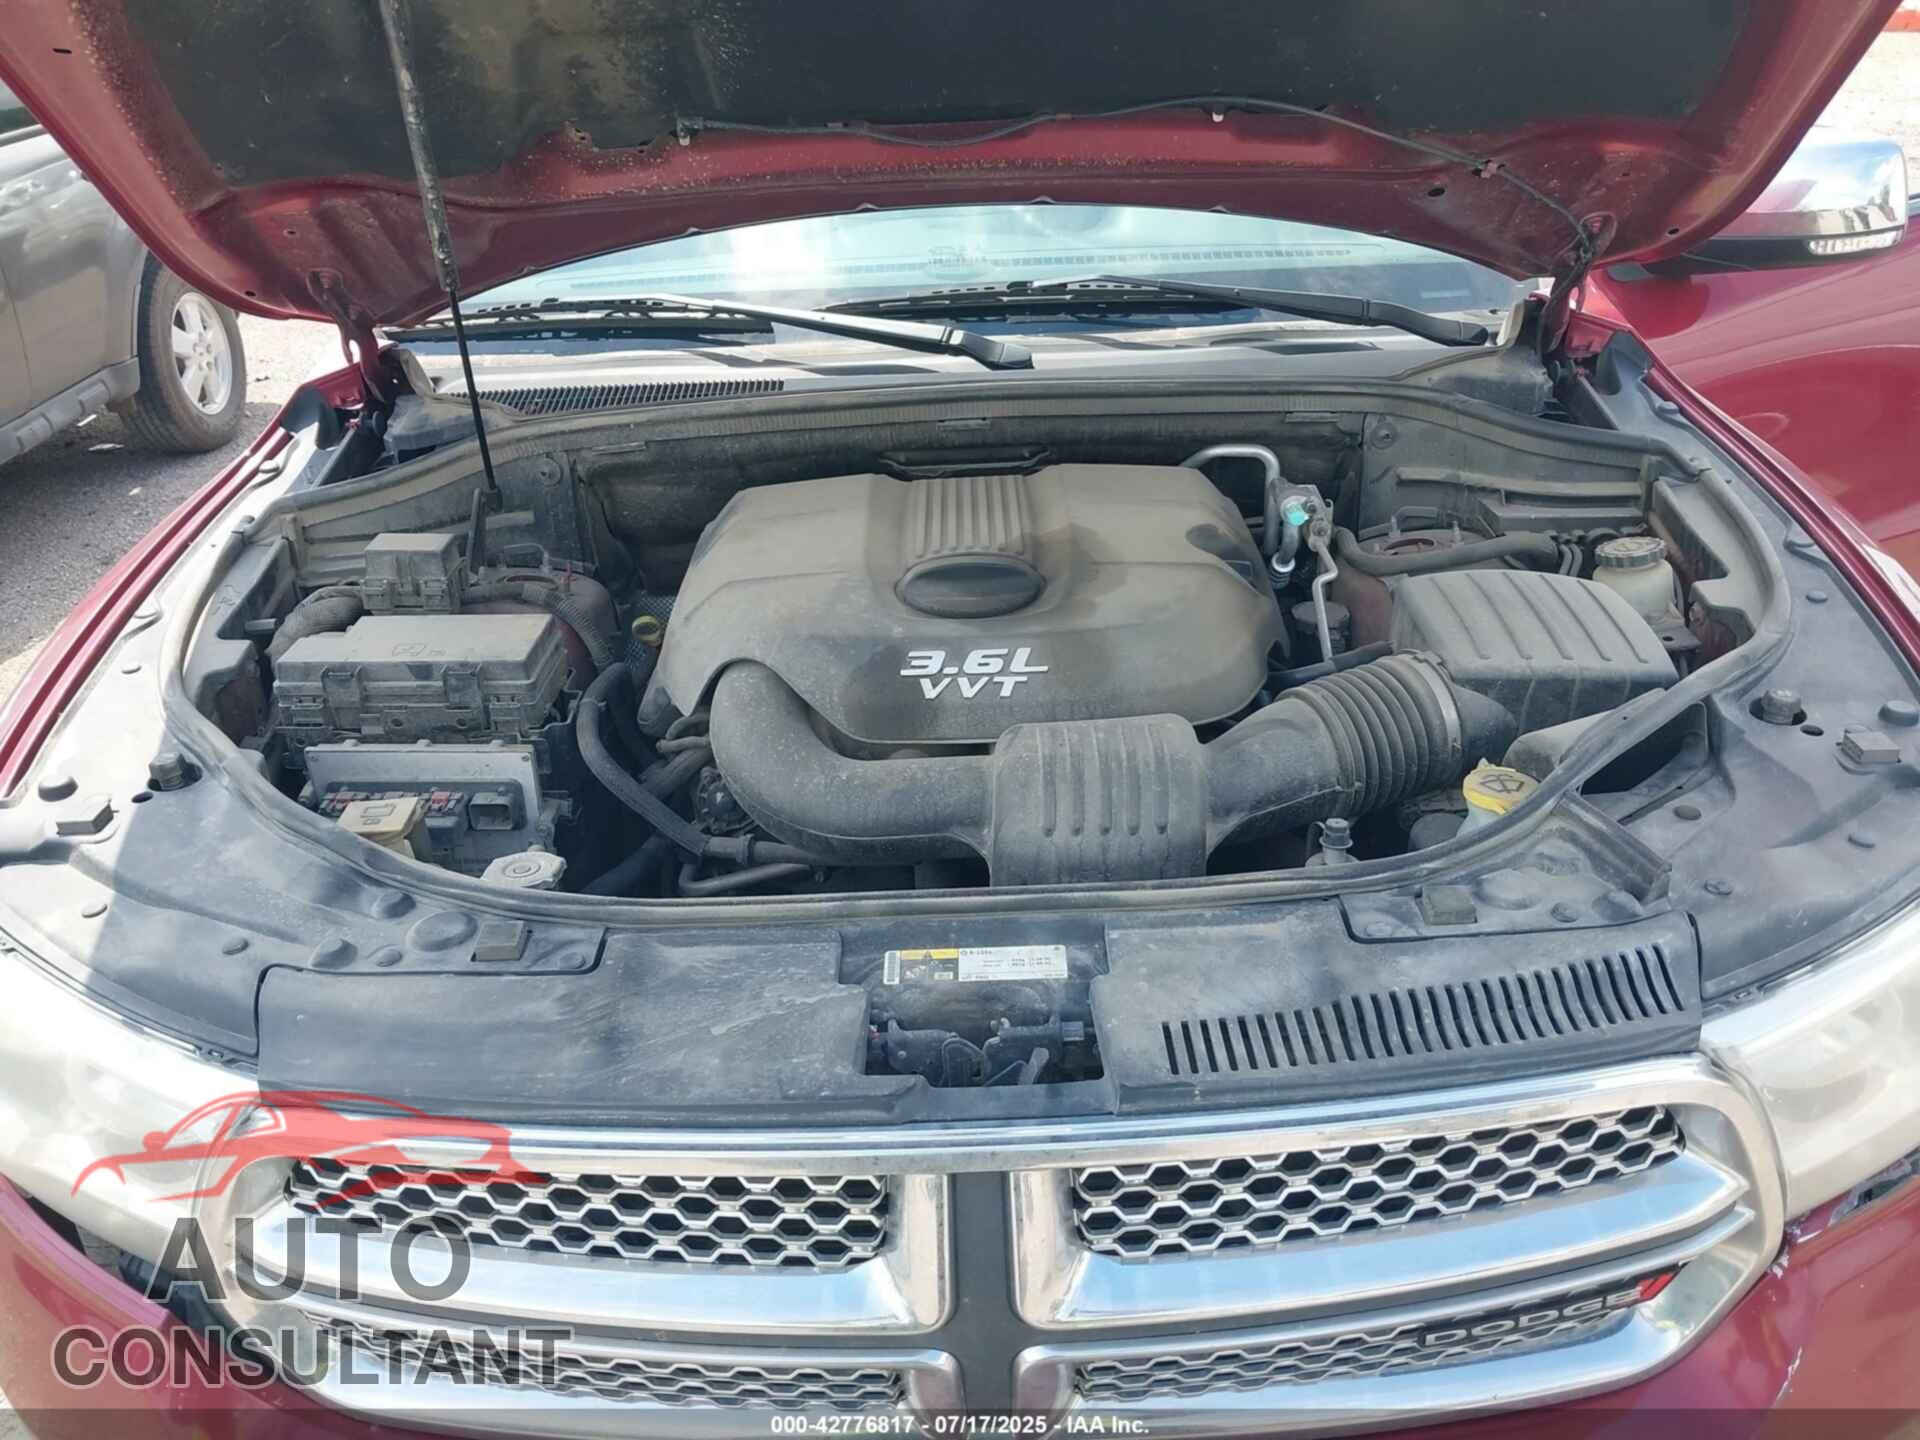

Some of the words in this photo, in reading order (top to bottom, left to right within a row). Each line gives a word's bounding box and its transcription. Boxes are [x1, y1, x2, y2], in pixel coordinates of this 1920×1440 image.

[900, 647, 1049, 676] 3.6L
[919, 676, 1028, 699] VVT
[1424, 1286, 1642, 1347] DODGE
